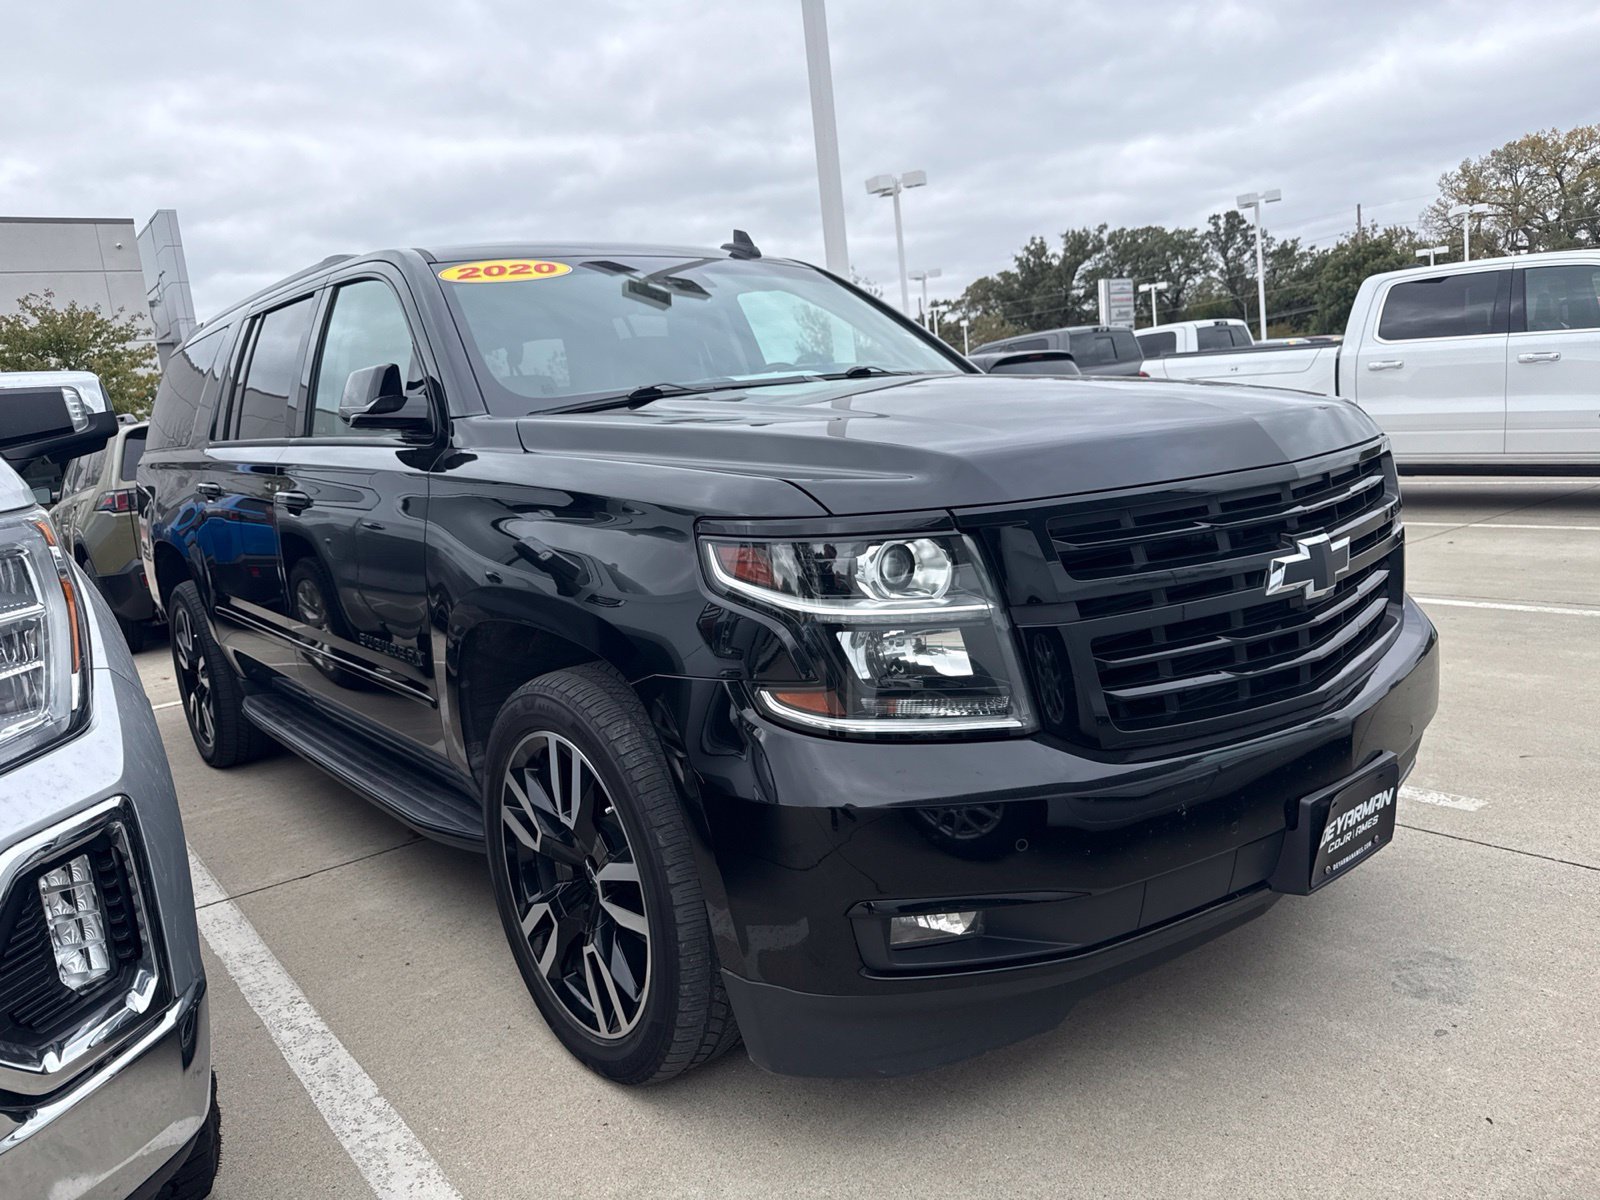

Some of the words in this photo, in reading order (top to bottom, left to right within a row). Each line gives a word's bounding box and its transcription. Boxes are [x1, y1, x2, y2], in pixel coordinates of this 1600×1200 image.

[457, 263, 557, 280] 2020
[1319, 787, 1394, 849] DEYARMAN
[1355, 814, 1379, 837] AMES
